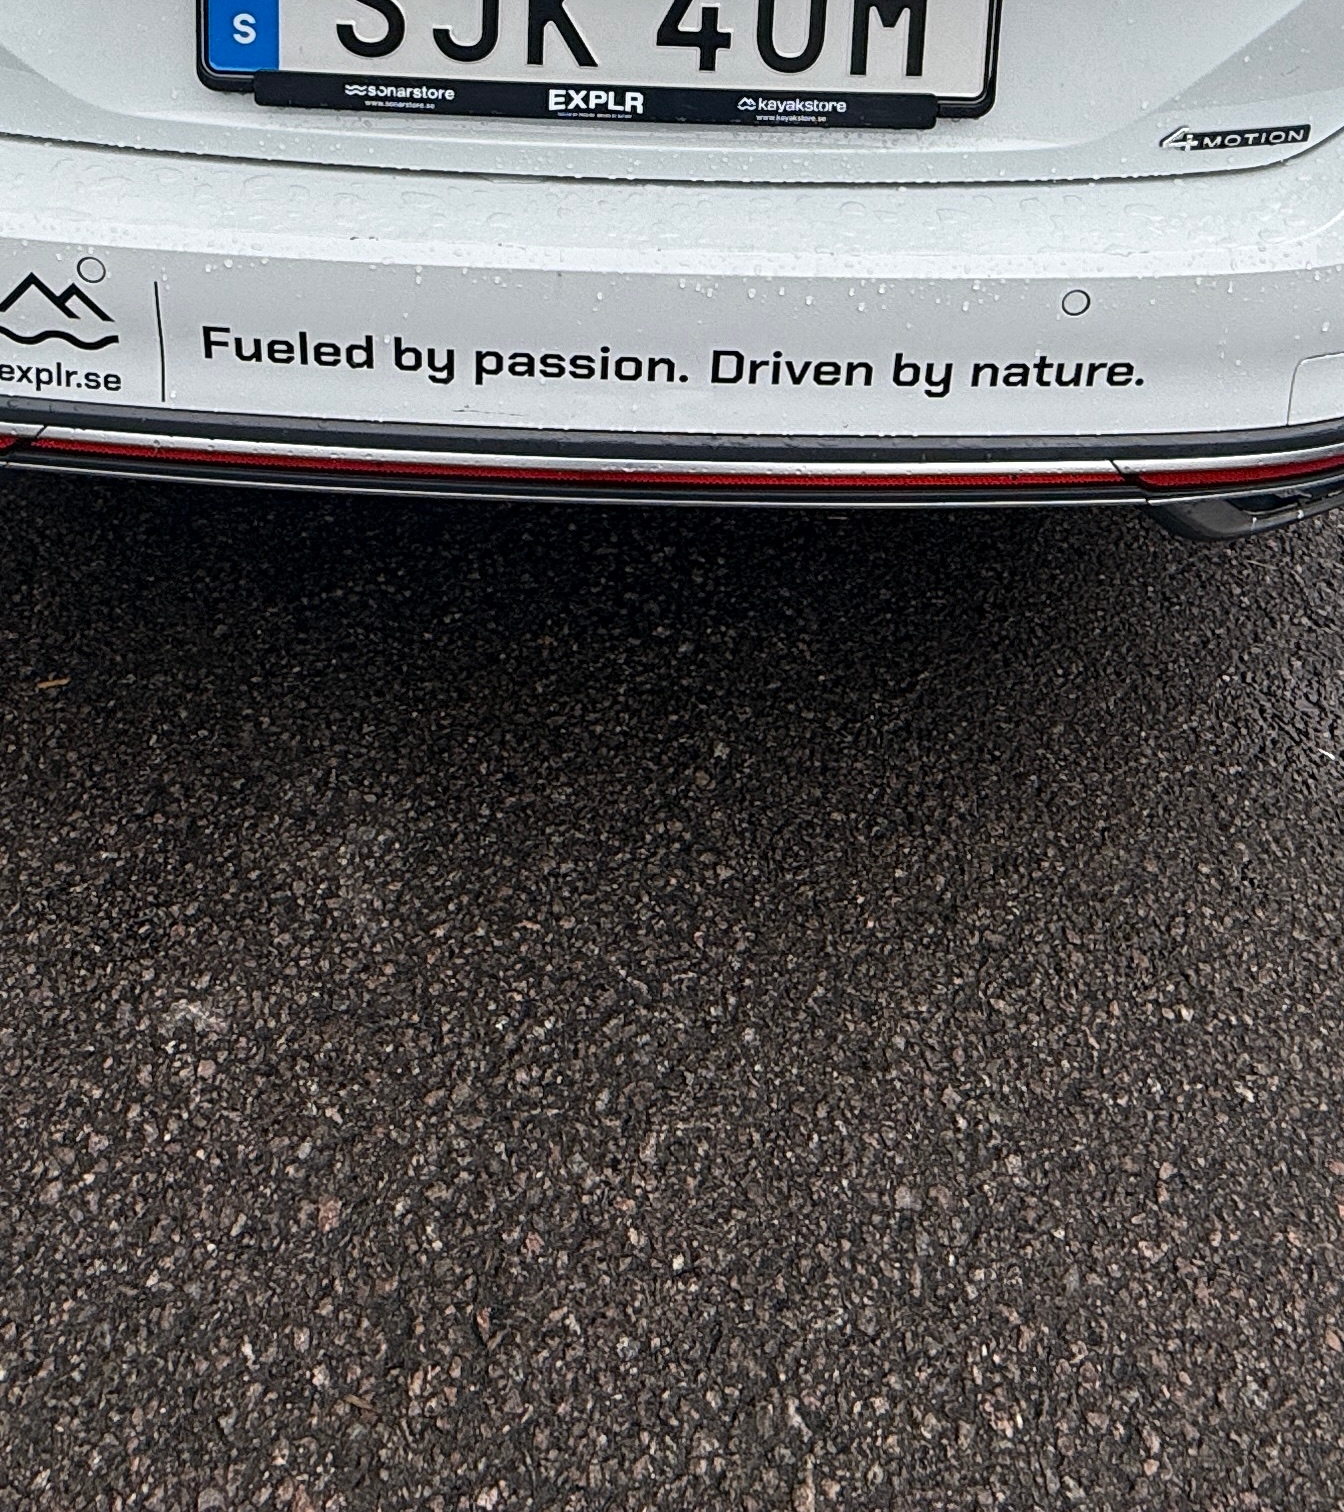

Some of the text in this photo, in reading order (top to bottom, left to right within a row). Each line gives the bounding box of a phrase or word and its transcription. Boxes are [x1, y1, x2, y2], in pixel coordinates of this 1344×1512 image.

[232, 13, 256, 44] S
[367, 85, 455, 101] sonarstore
[548, 88, 644, 114] EXPLR
[757, 97, 847, 113] kayakstore
[755, 114, 827, 123] www.kayakstore.se
[202, 325, 1144, 398] Fueled by passion. Driven by nature.
